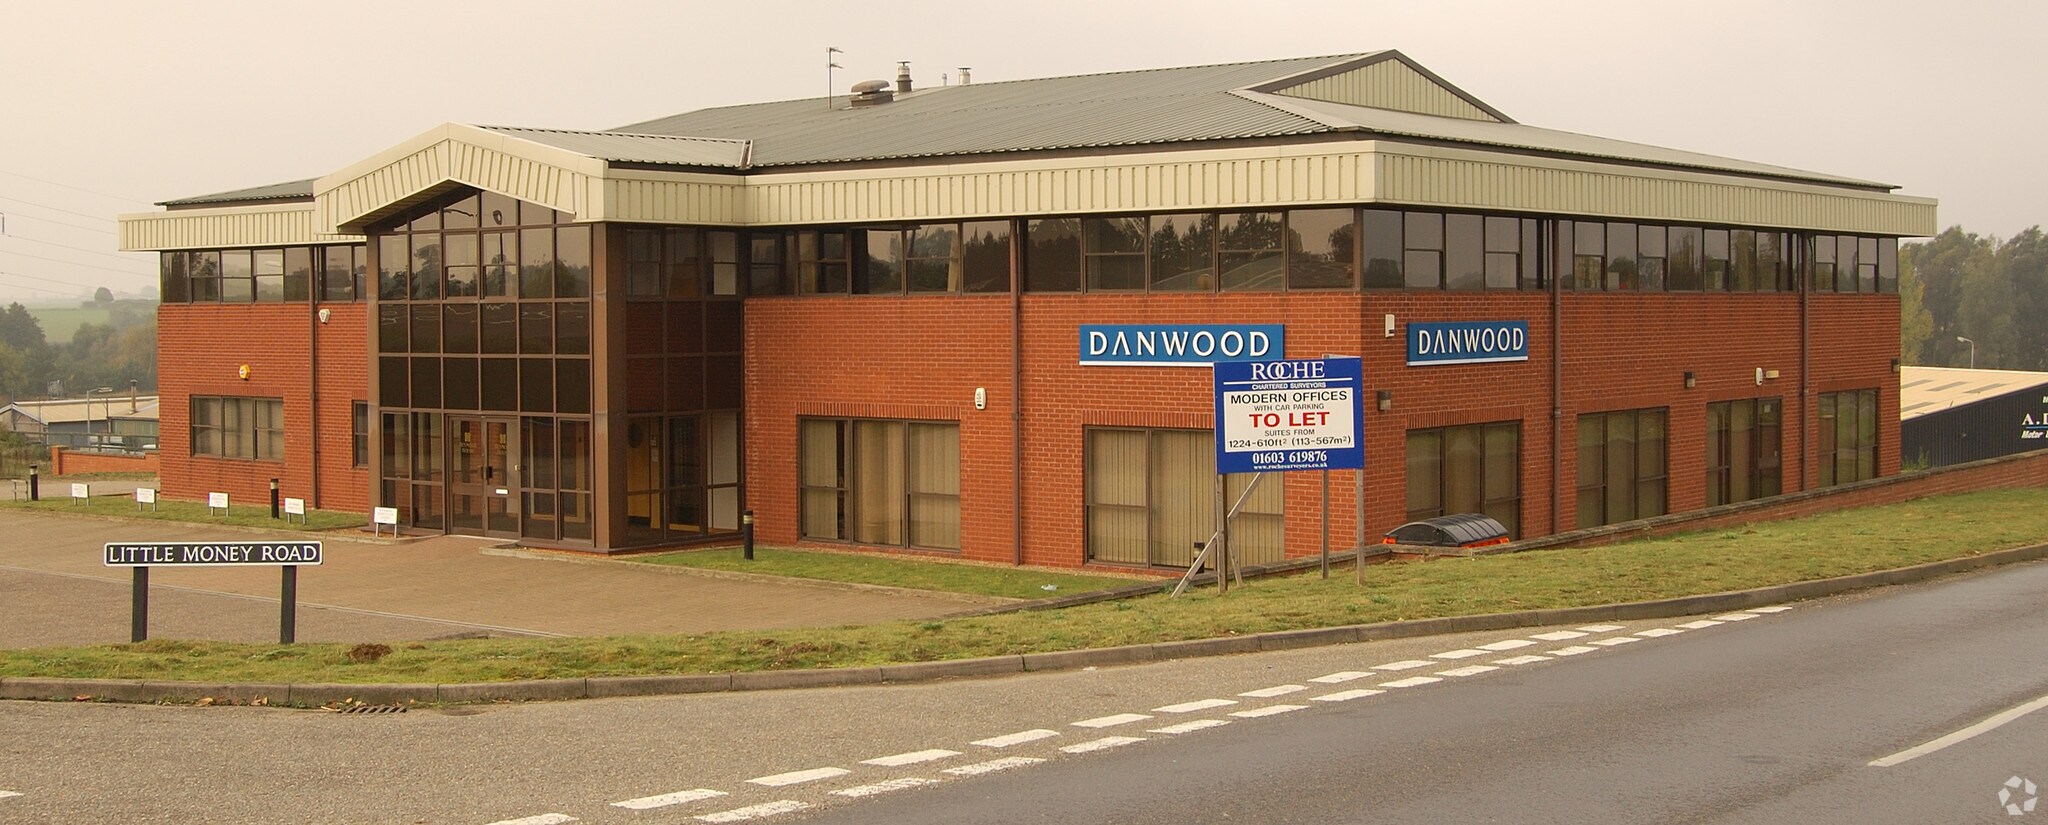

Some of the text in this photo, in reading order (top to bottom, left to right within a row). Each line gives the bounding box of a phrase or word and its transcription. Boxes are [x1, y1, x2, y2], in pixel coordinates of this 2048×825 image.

[1089, 330, 1270, 357] DANWOOD
[1418, 327, 1524, 354] DANWOOD
[1251, 361, 1325, 380] ROCHE
[1231, 391, 1347, 404] MODERN OFFICES
[1249, 412, 1330, 428] TO LET
[1252, 450, 1327, 464] 01603 619876
[109, 545, 317, 562] LITTLE MONEY ROAD
